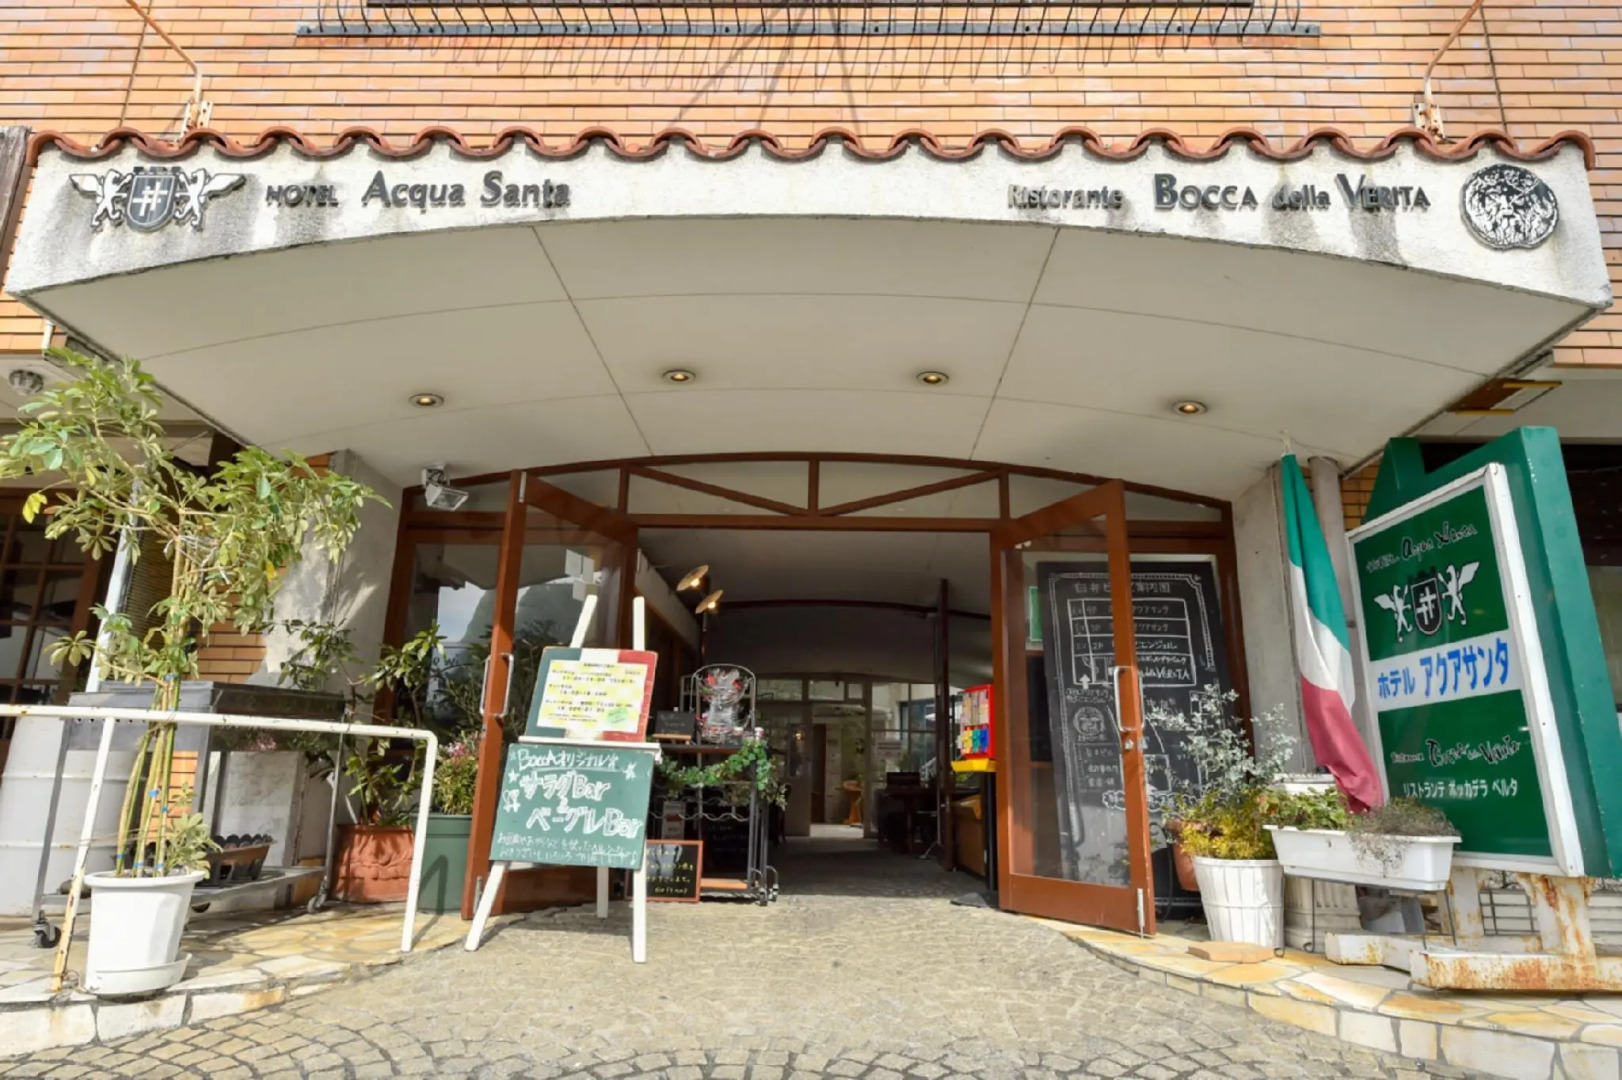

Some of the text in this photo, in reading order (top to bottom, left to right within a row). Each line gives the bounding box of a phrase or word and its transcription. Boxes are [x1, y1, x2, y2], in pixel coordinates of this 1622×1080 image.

[265, 170, 572, 214] HOTEL Acqua Santa
[1007, 172, 1432, 212] Ristorante BOCCA della VERITA
[1377, 637, 1509, 699] ホテル アクアサンタ
[1403, 781, 1446, 799] リストランテ
